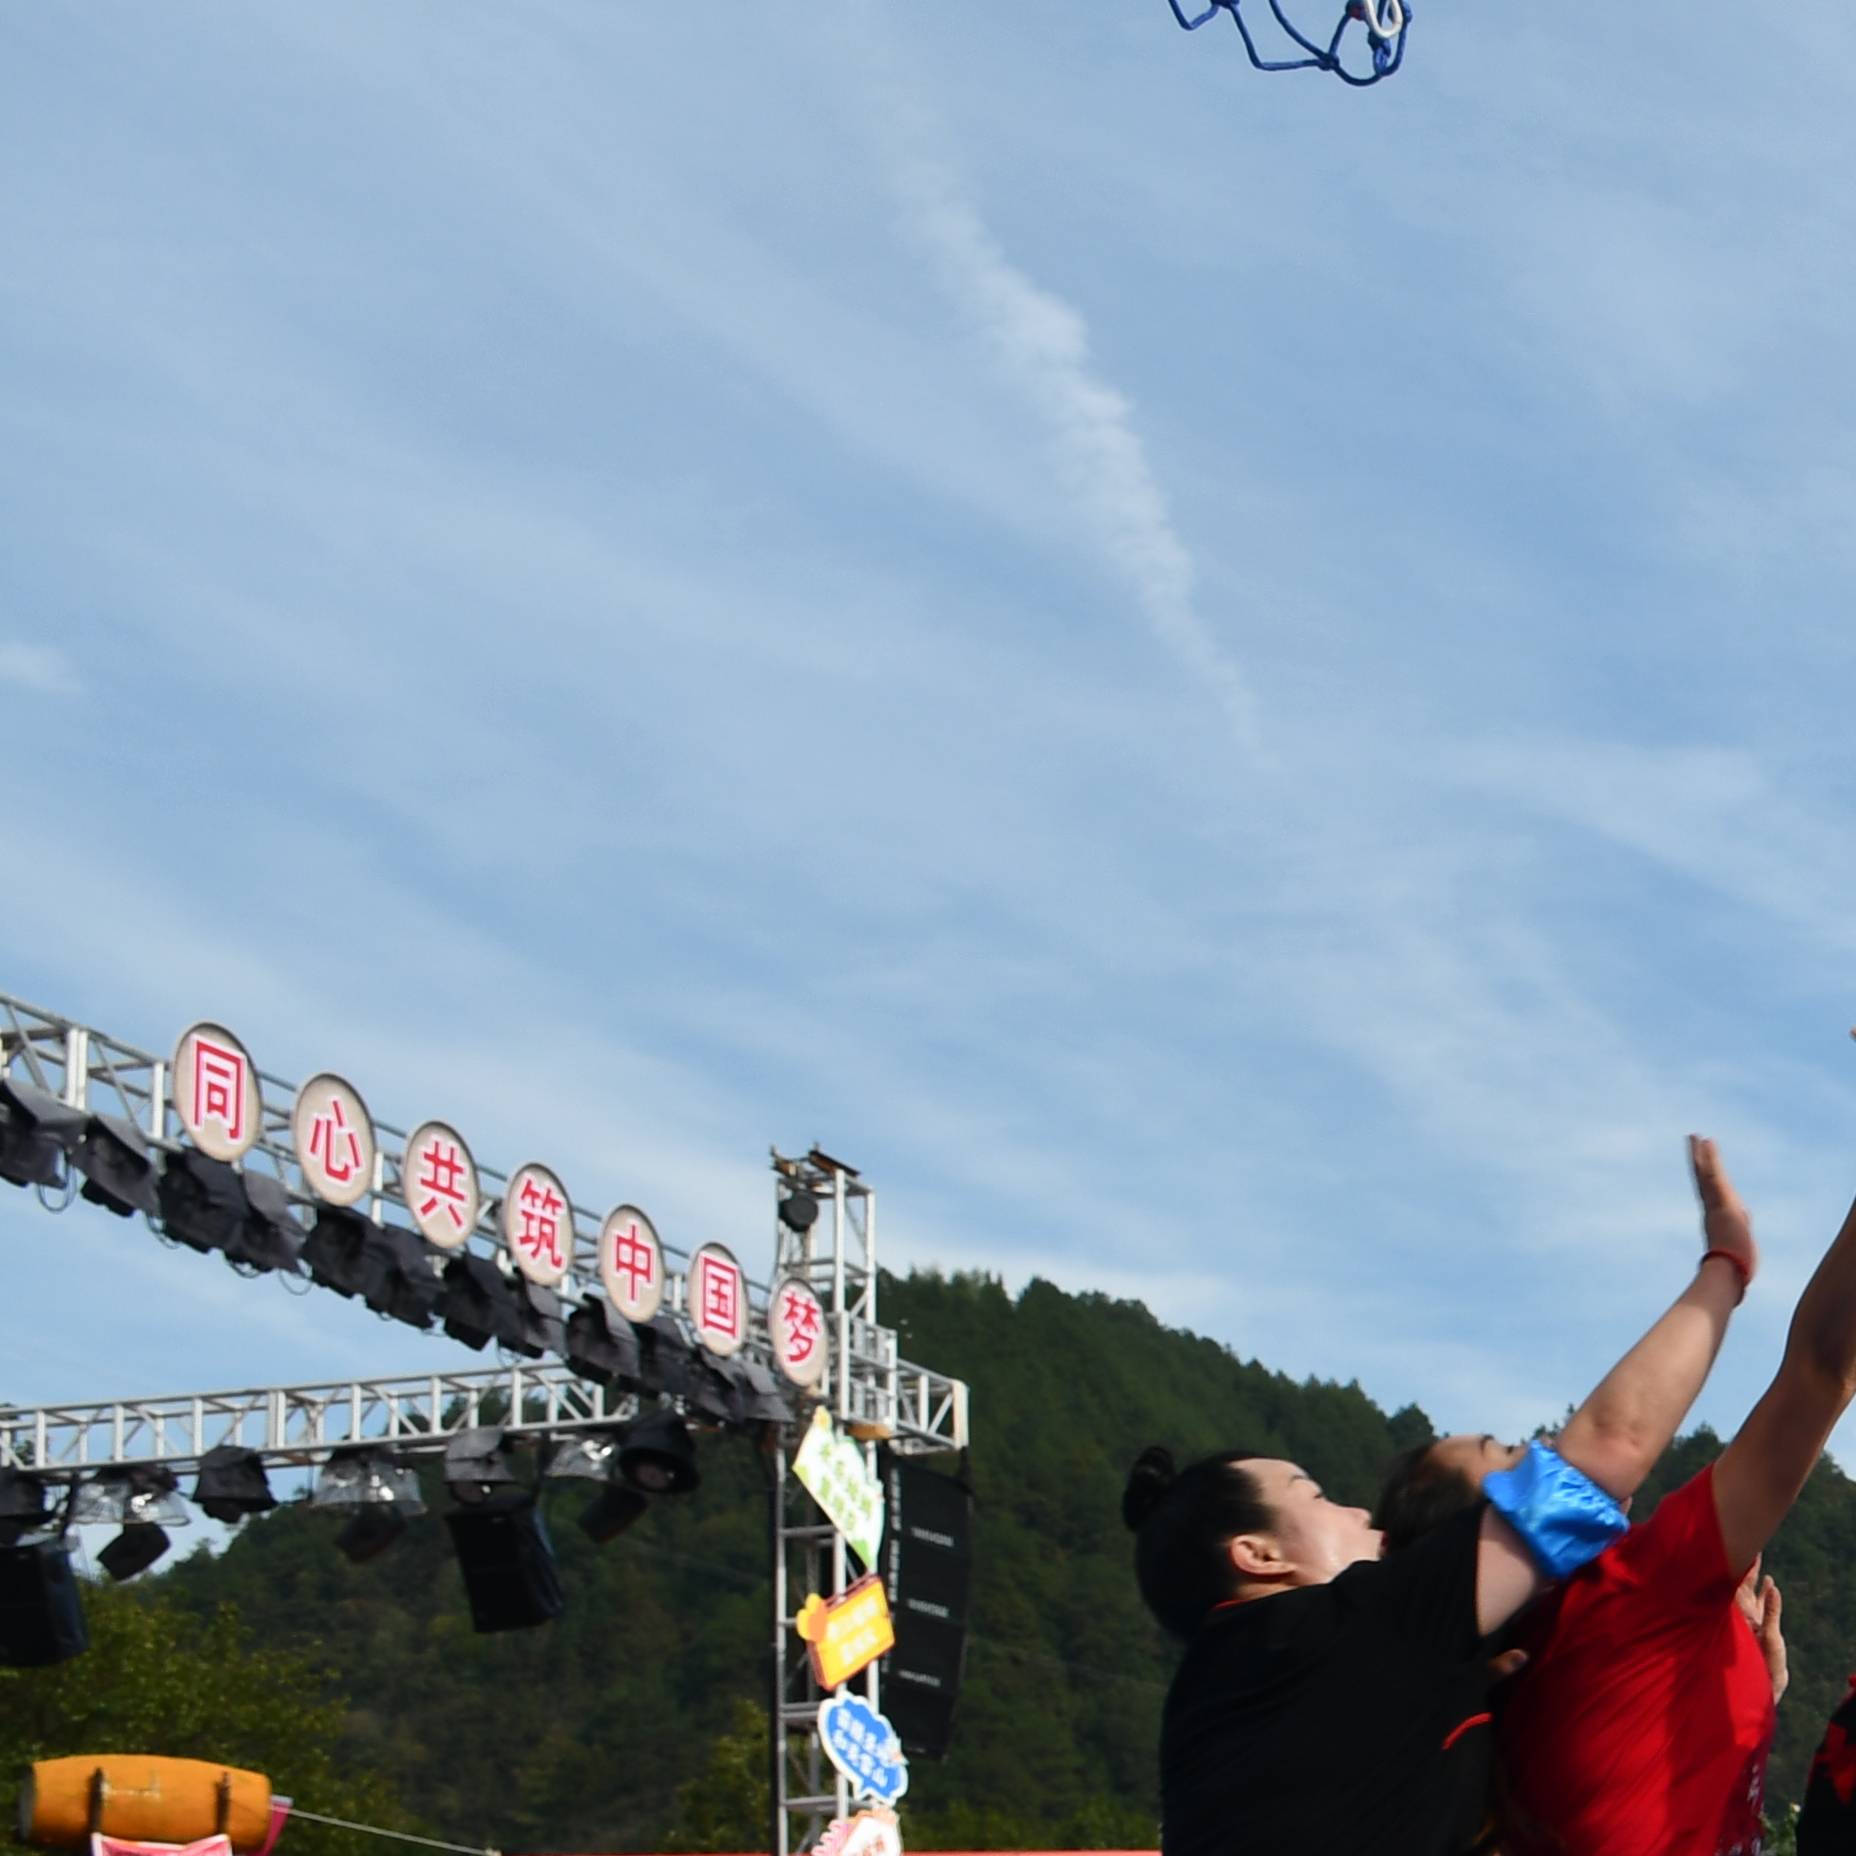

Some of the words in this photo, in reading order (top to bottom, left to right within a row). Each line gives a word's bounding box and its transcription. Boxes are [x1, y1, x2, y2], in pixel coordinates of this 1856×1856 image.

[191, 1034, 820, 1364] 同心共筑中国梦
